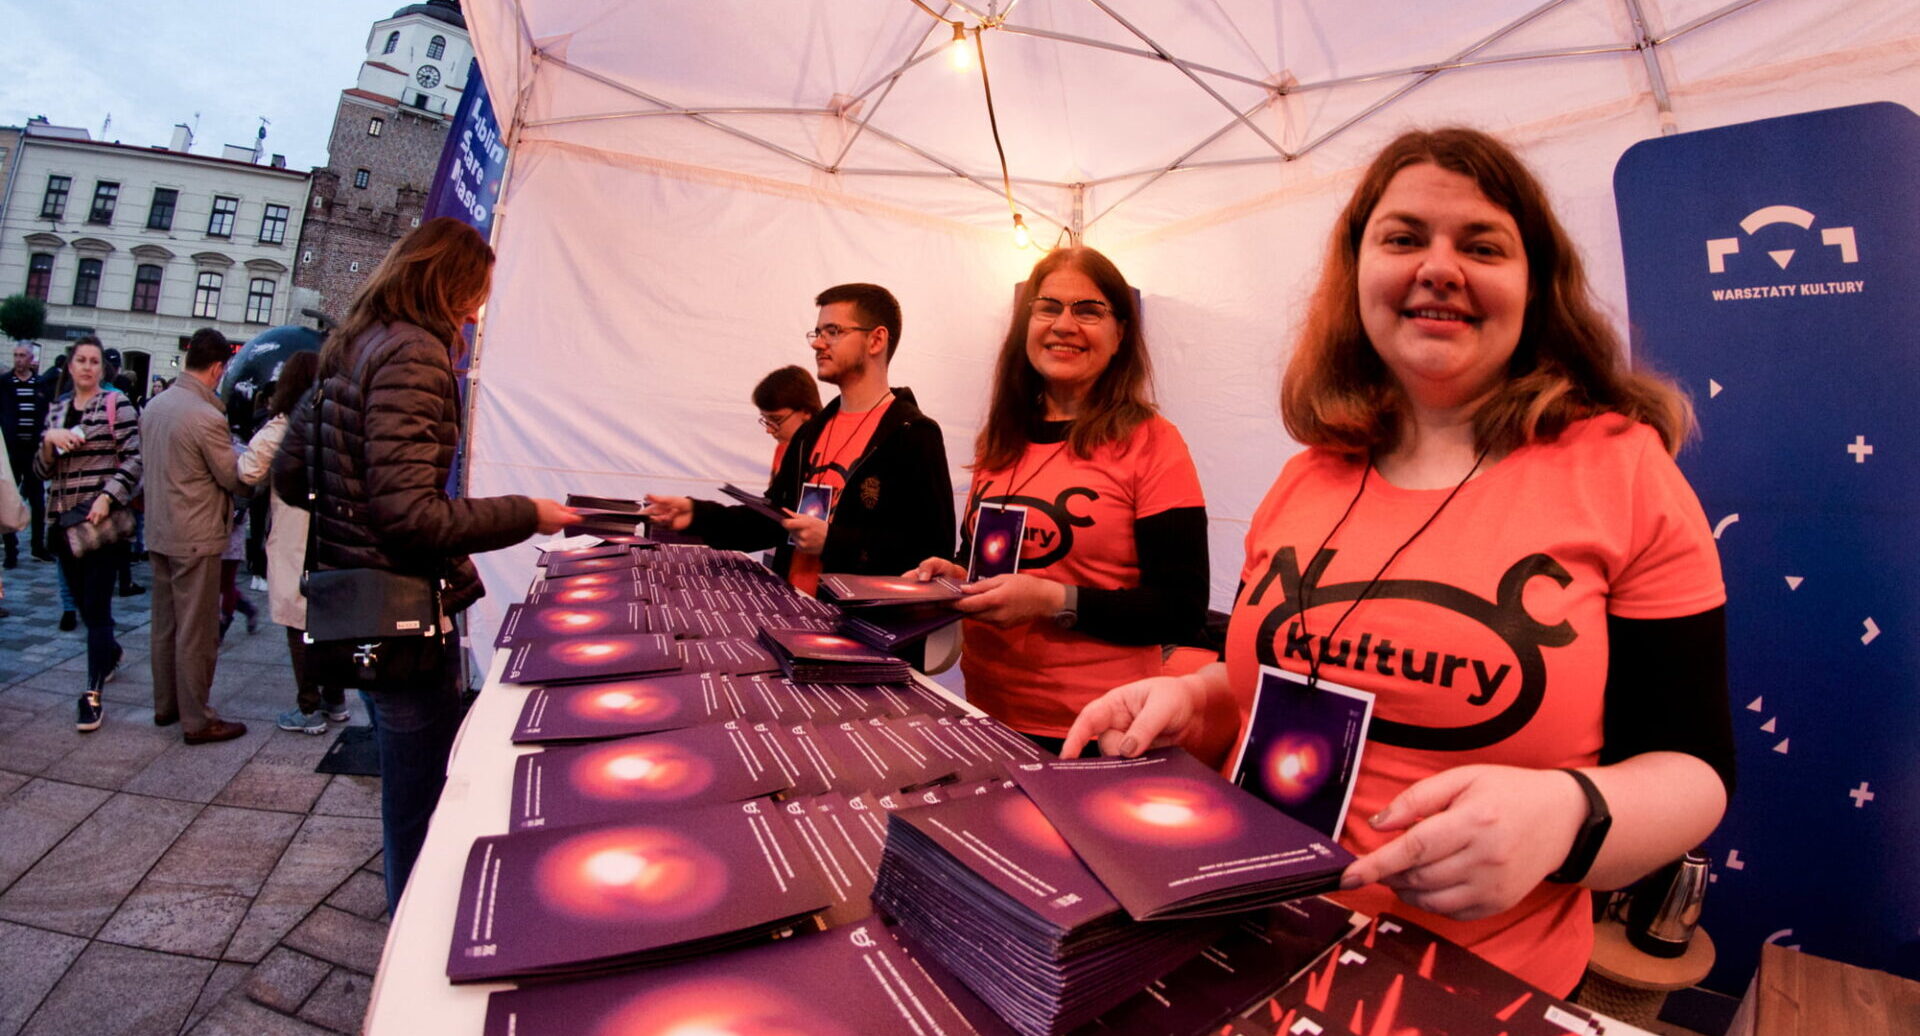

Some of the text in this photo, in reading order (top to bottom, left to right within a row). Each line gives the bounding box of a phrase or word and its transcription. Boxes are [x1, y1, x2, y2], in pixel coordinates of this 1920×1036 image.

[460, 130, 484, 185] Sare
[1712, 281, 1865, 301] WARSZTATY KULTURY
[1284, 621, 1512, 706] kultury
